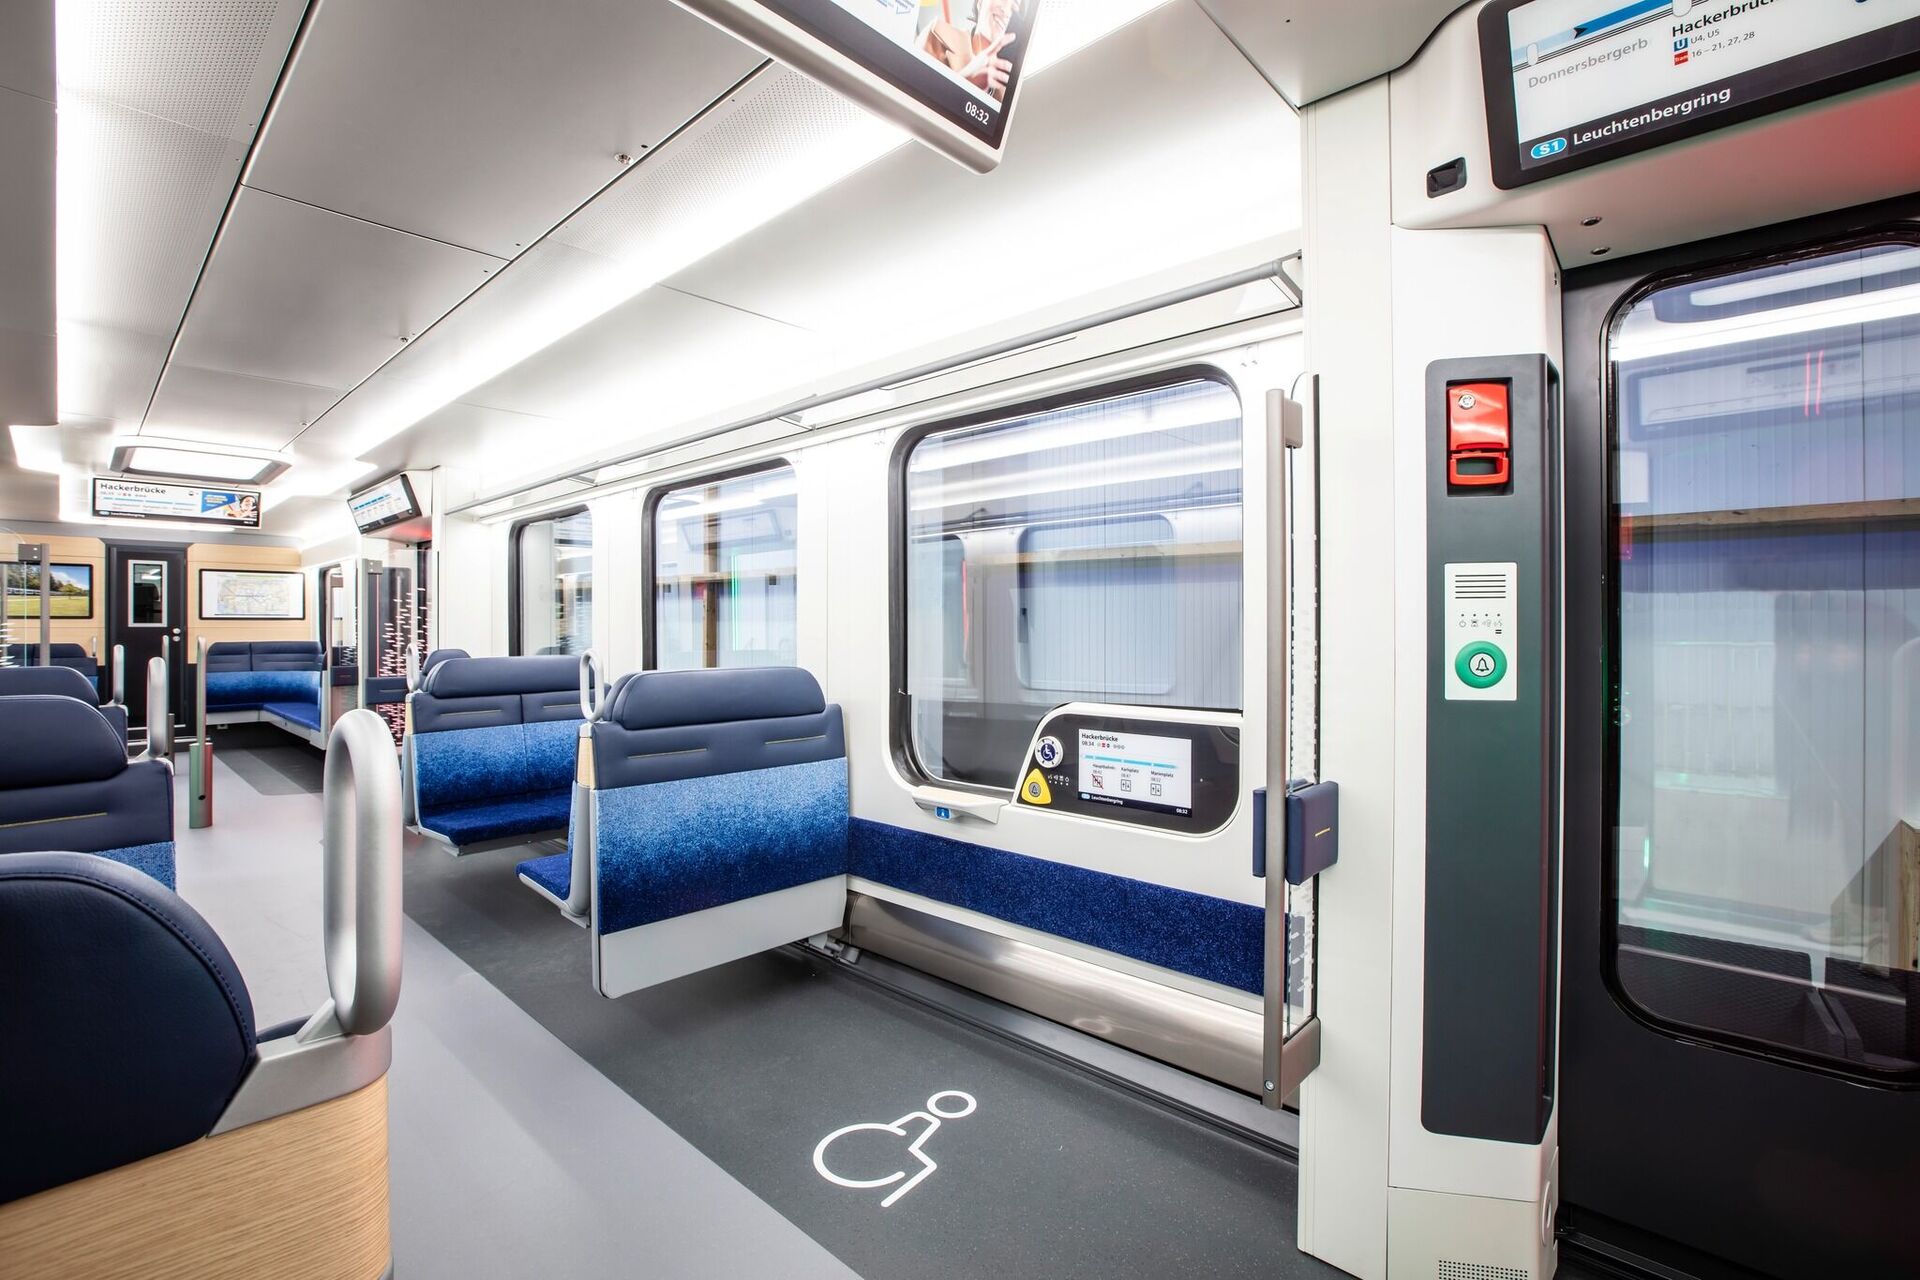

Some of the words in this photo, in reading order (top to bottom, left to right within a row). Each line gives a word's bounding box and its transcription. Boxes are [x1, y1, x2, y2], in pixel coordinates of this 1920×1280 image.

[1690, 34, 1706, 44] U4,
[1707, 28, 1720, 39] U5
[1692, 48, 1702, 58] 16
[1711, 42, 1726, 52] 21,
[1727, 36, 1741, 47] 27,
[1743, 31, 1755, 41] 28
[1528, 38, 1649, 88] Donnersbergerb
[965, 101, 990, 126] 08:32
[1573, 88, 1732, 146] Leuchtenbergring
[100, 483, 166, 494] Hackerbrücke
[1081, 733, 1118, 742] Hackerbrücke
